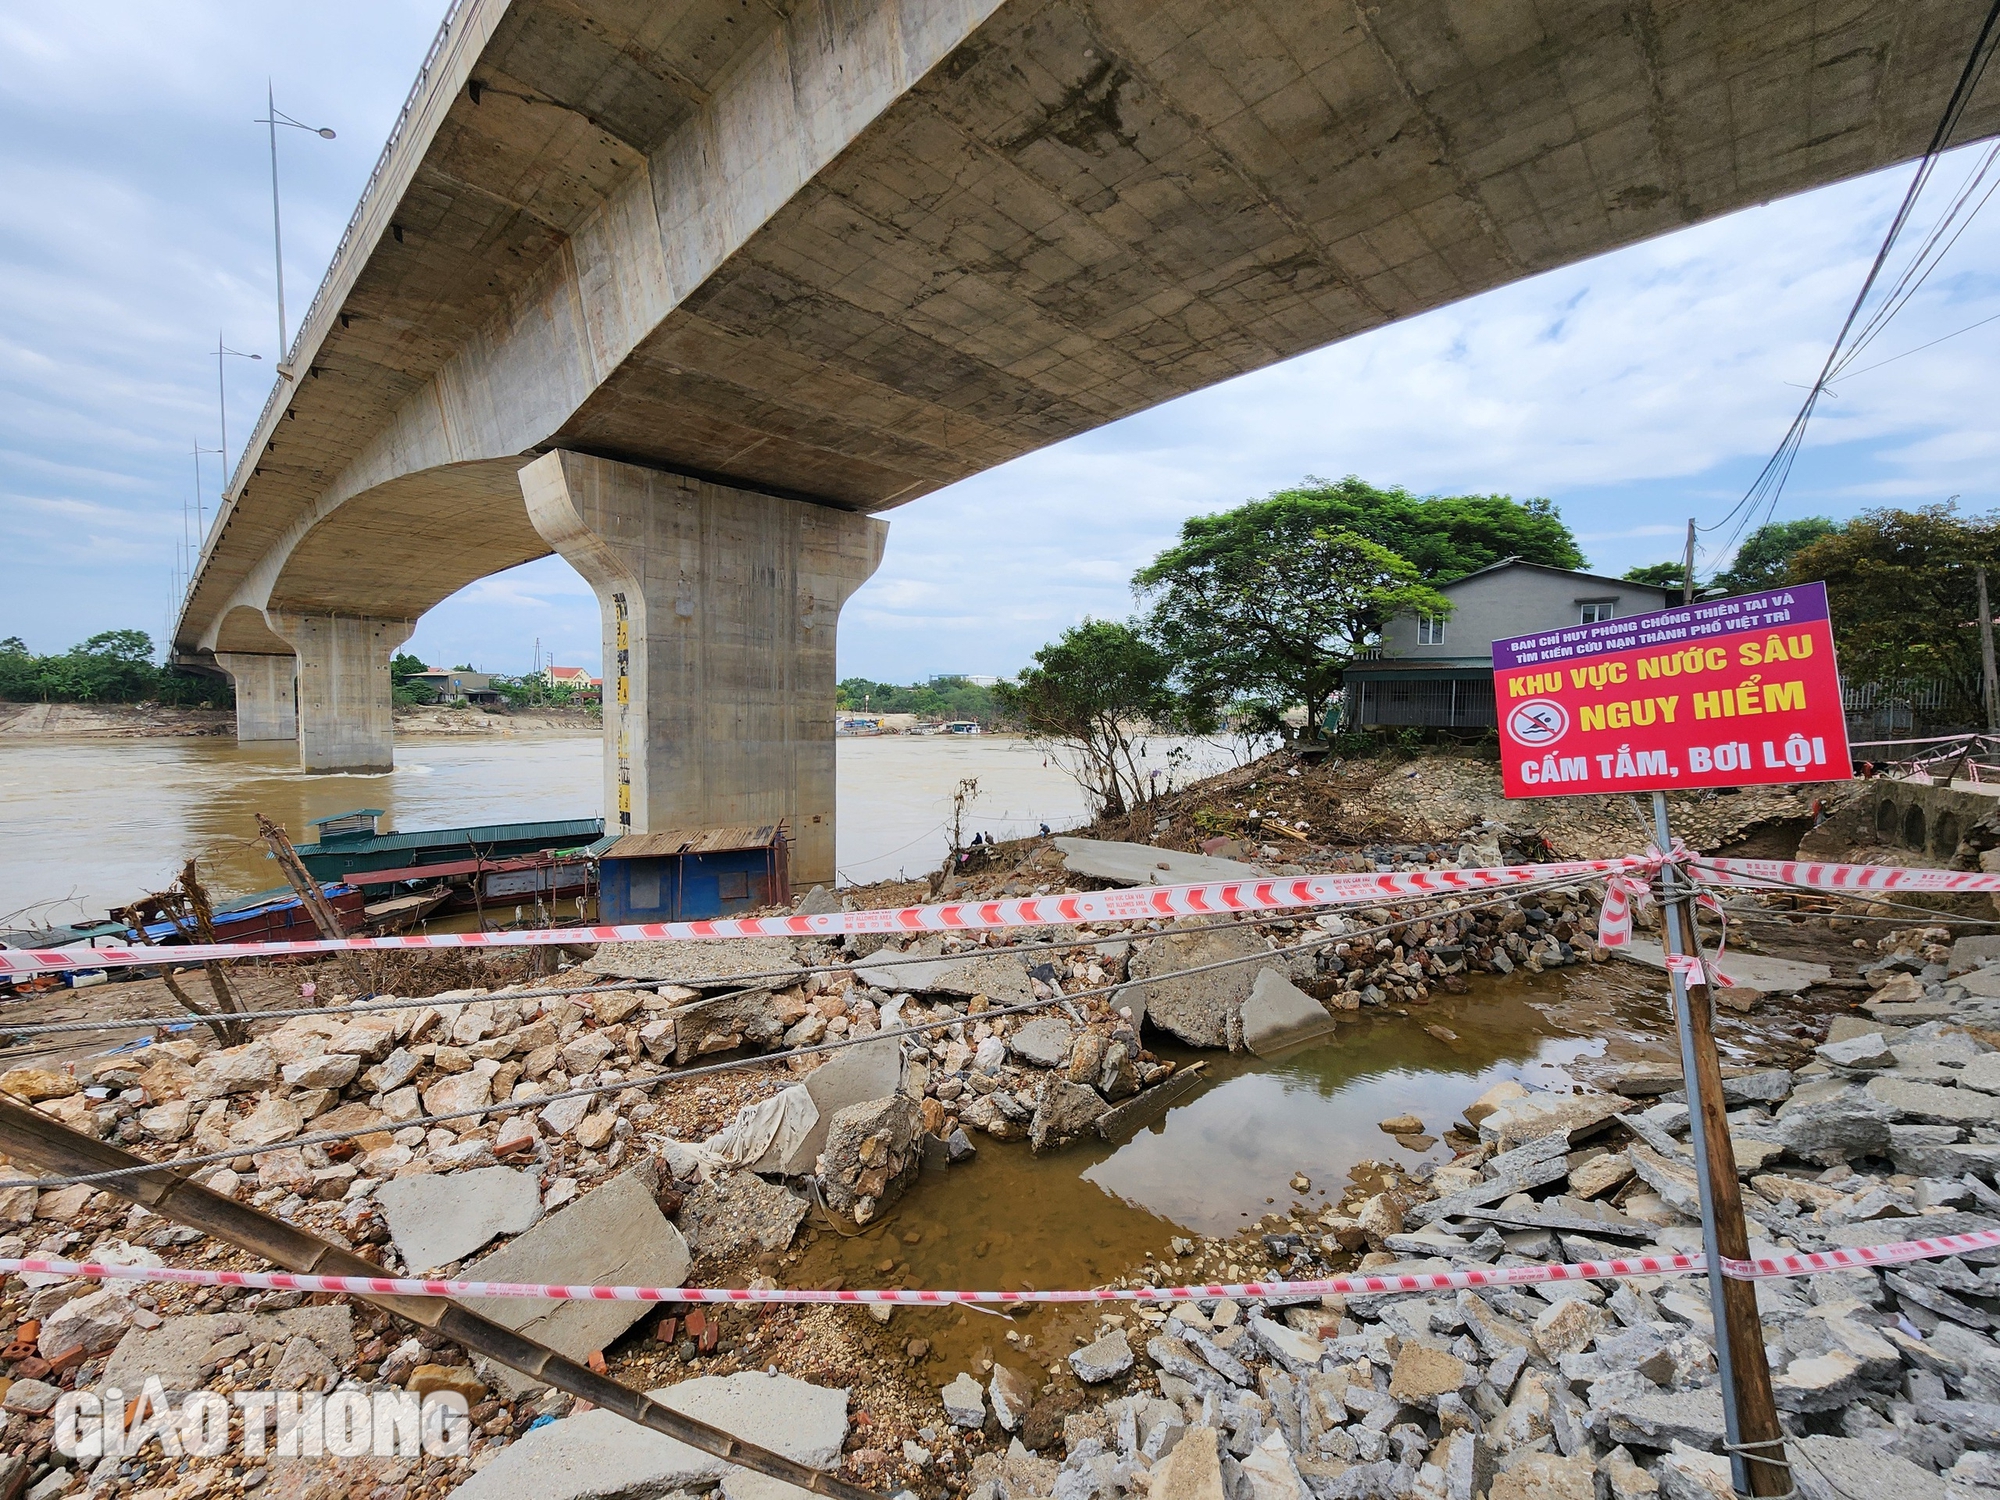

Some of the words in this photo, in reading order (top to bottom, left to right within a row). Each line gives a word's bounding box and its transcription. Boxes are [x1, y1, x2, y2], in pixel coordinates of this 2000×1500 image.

[1511, 639, 1536, 652] BAN
[1539, 633, 1560, 647] CHỈ
[1563, 630, 1588, 643] HUY
[1591, 621, 1638, 638] PHÒNG
[1641, 612, 1691, 629] CHỐNG
[1694, 603, 1740, 620] THIÊN
[1743, 598, 1767, 611] TAI
[1771, 592, 1795, 607] VÀ
[1516, 650, 1538, 664] TÌM
[1541, 646, 1573, 661] KIẾM
[1577, 641, 1603, 654] CỨU
[1606, 636, 1636, 650] NẠN
[1639, 628, 1687, 645] THÀNH
[1690, 618, 1722, 636] PHỐ
[1725, 614, 1760, 630] VIỆT
[1763, 609, 1791, 624] TRÌ
[1508, 671, 1563, 698] KHU
[1570, 661, 1628, 691] VỰC
[1637, 646, 1728, 680] NƯỚC
[1738, 634, 1814, 666] SÂU
[1579, 695, 1680, 732] NGUY
[1693, 674, 1807, 720] HIỂM
[1520, 750, 1589, 784] CẤM
[1596, 743, 1679, 779] TẮM,
[1688, 741, 1752, 773] BƠI
[1762, 733, 1827, 773] LỘI
